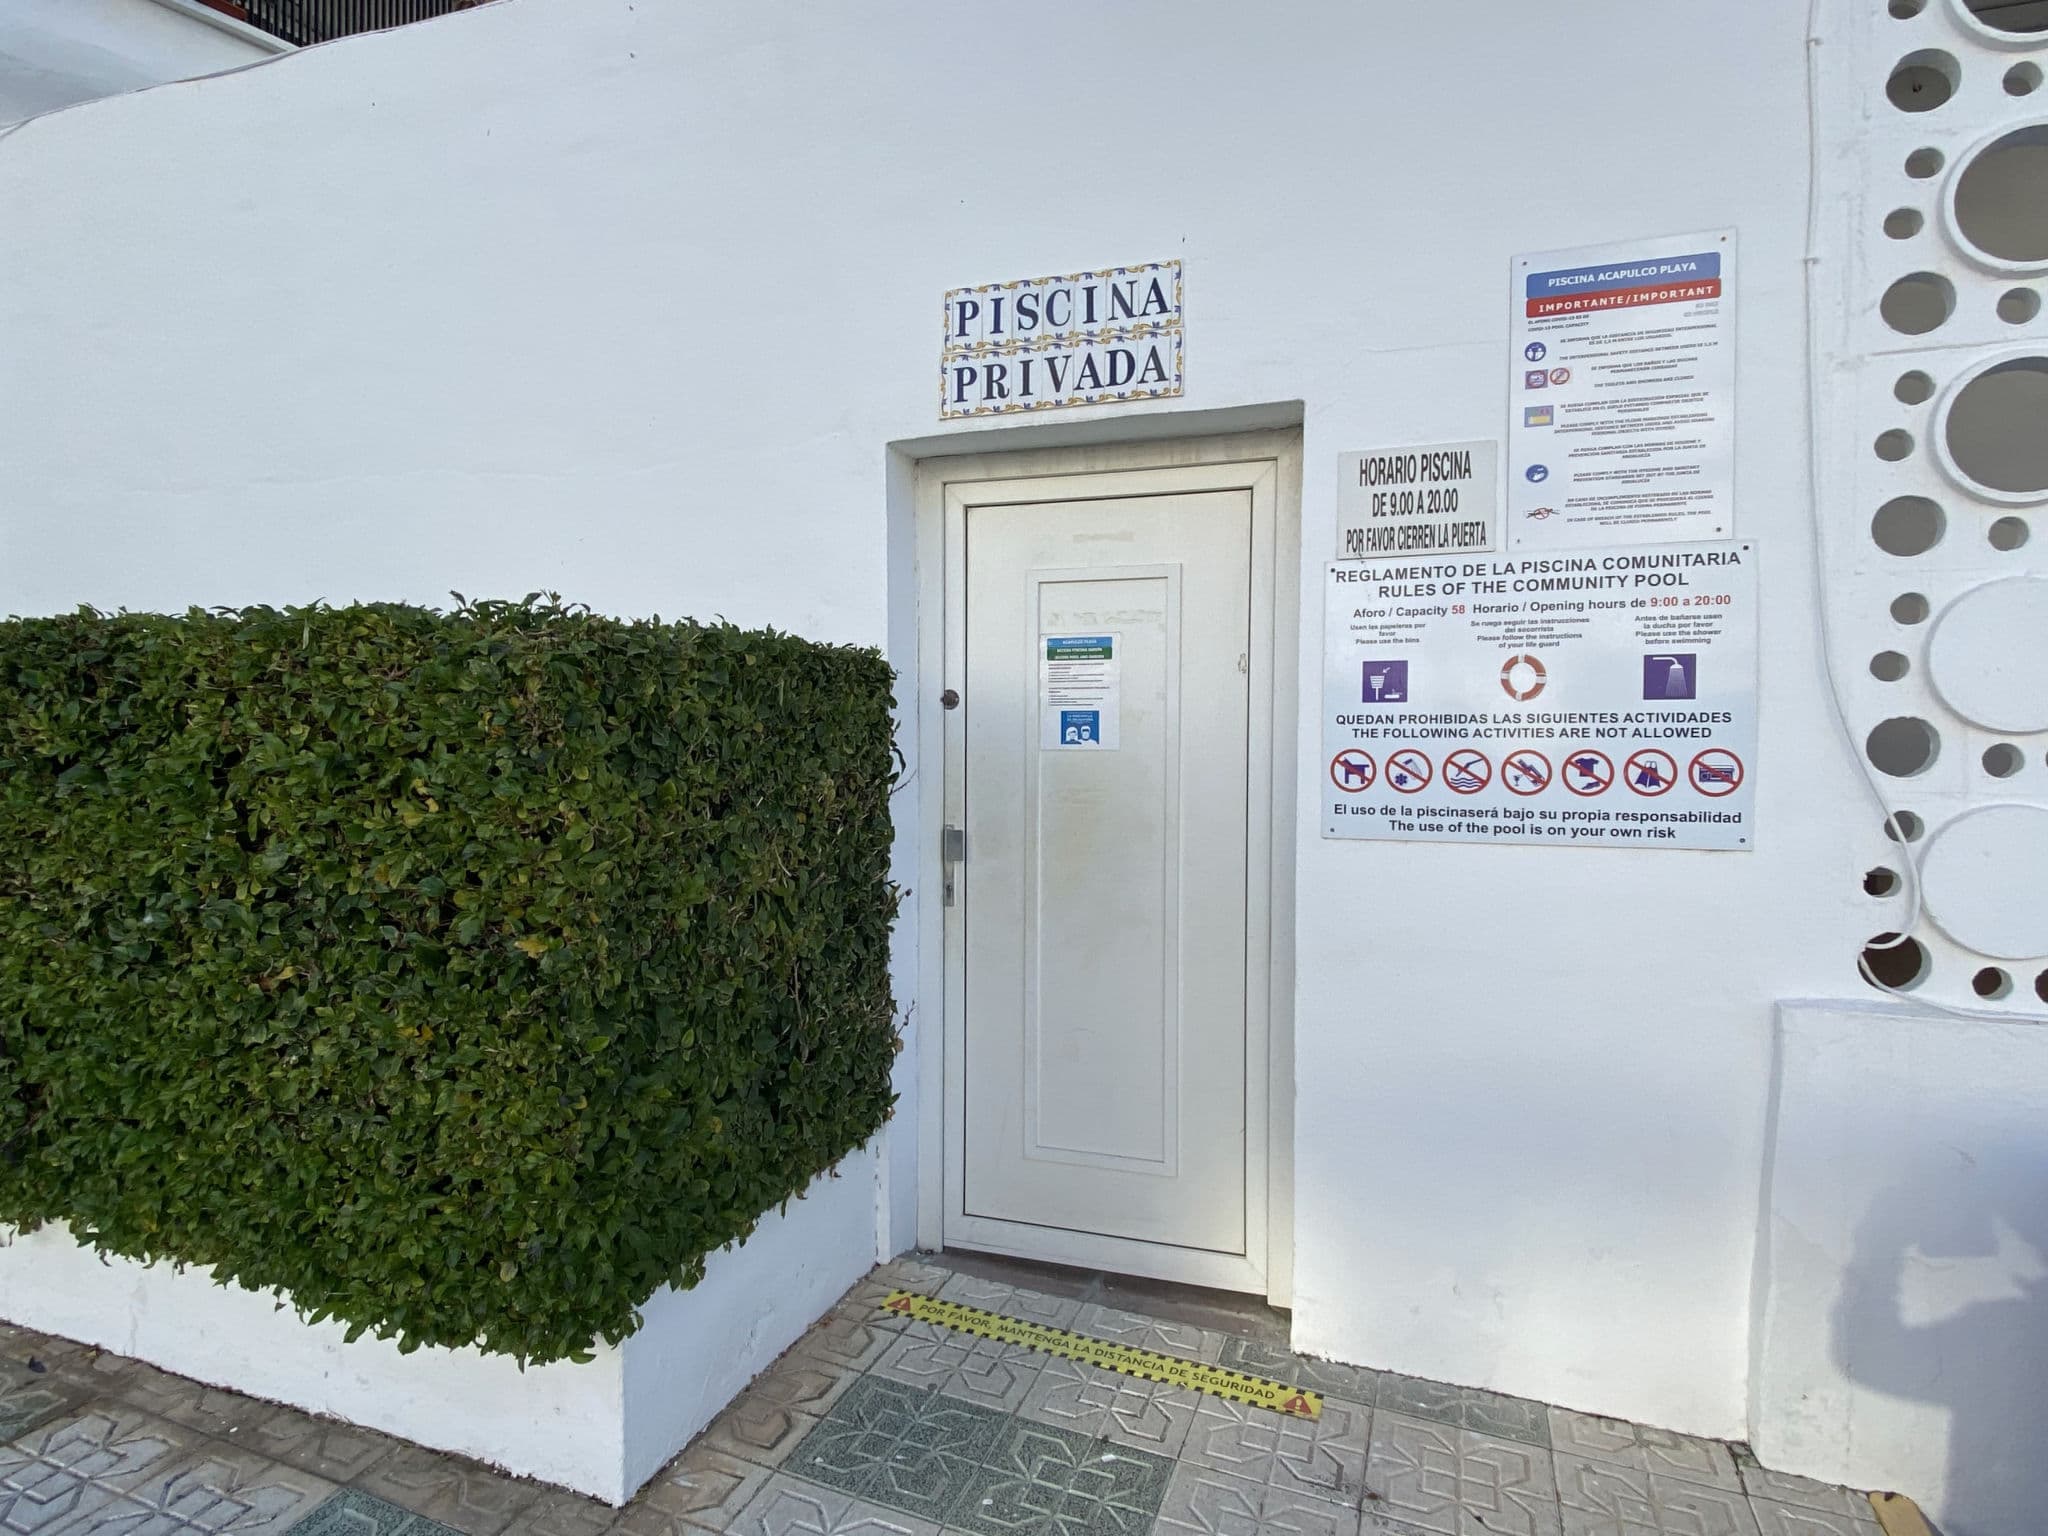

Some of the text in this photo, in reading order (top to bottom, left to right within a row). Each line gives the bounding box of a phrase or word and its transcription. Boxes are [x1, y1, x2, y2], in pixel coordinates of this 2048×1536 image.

[1549, 262, 1697, 287] PISCINA ACAPULCO PLAYA
[955, 277, 1171, 337] PISCINA
[1538, 286, 1714, 313] IMPORTANTE/IMPORTANT
[953, 345, 1169, 403] PRIVADA
[1360, 450, 1472, 487] HORARIO PISCINA
[1373, 488, 1459, 517] DE 9.00 A 20.00
[1346, 521, 1486, 553] POR FAVOR CIERREN LA PUERTA
[1336, 552, 1741, 583] REGLAMENTO DE LA PISCINA COMUNITARIA
[1379, 572, 1689, 598] RULES OF THE COMMUNITY POOL
[1353, 594, 1731, 619] Aforo / Capacity 58 Horario / Opening hours de 9:00 a 20:00
[1671, 637, 1711, 645] swimming
[1336, 712, 1732, 726] QUEDAN PROHIBIDAS LAS SIGUIENTES ACTIVIDADES
[1352, 727, 1712, 738] THE FOLLOWING ACTIVITIES ARE NOT ALLOWED
[1334, 804, 1742, 824] El uso de la piscinaserá bajo su propia responsabilidad
[1389, 820, 1676, 839] The use of the pool is on your own risk
[919, 1304, 1276, 1399] POR FAVOR, MANTENGA LA DISTANCIA DE SEGURIDAD
